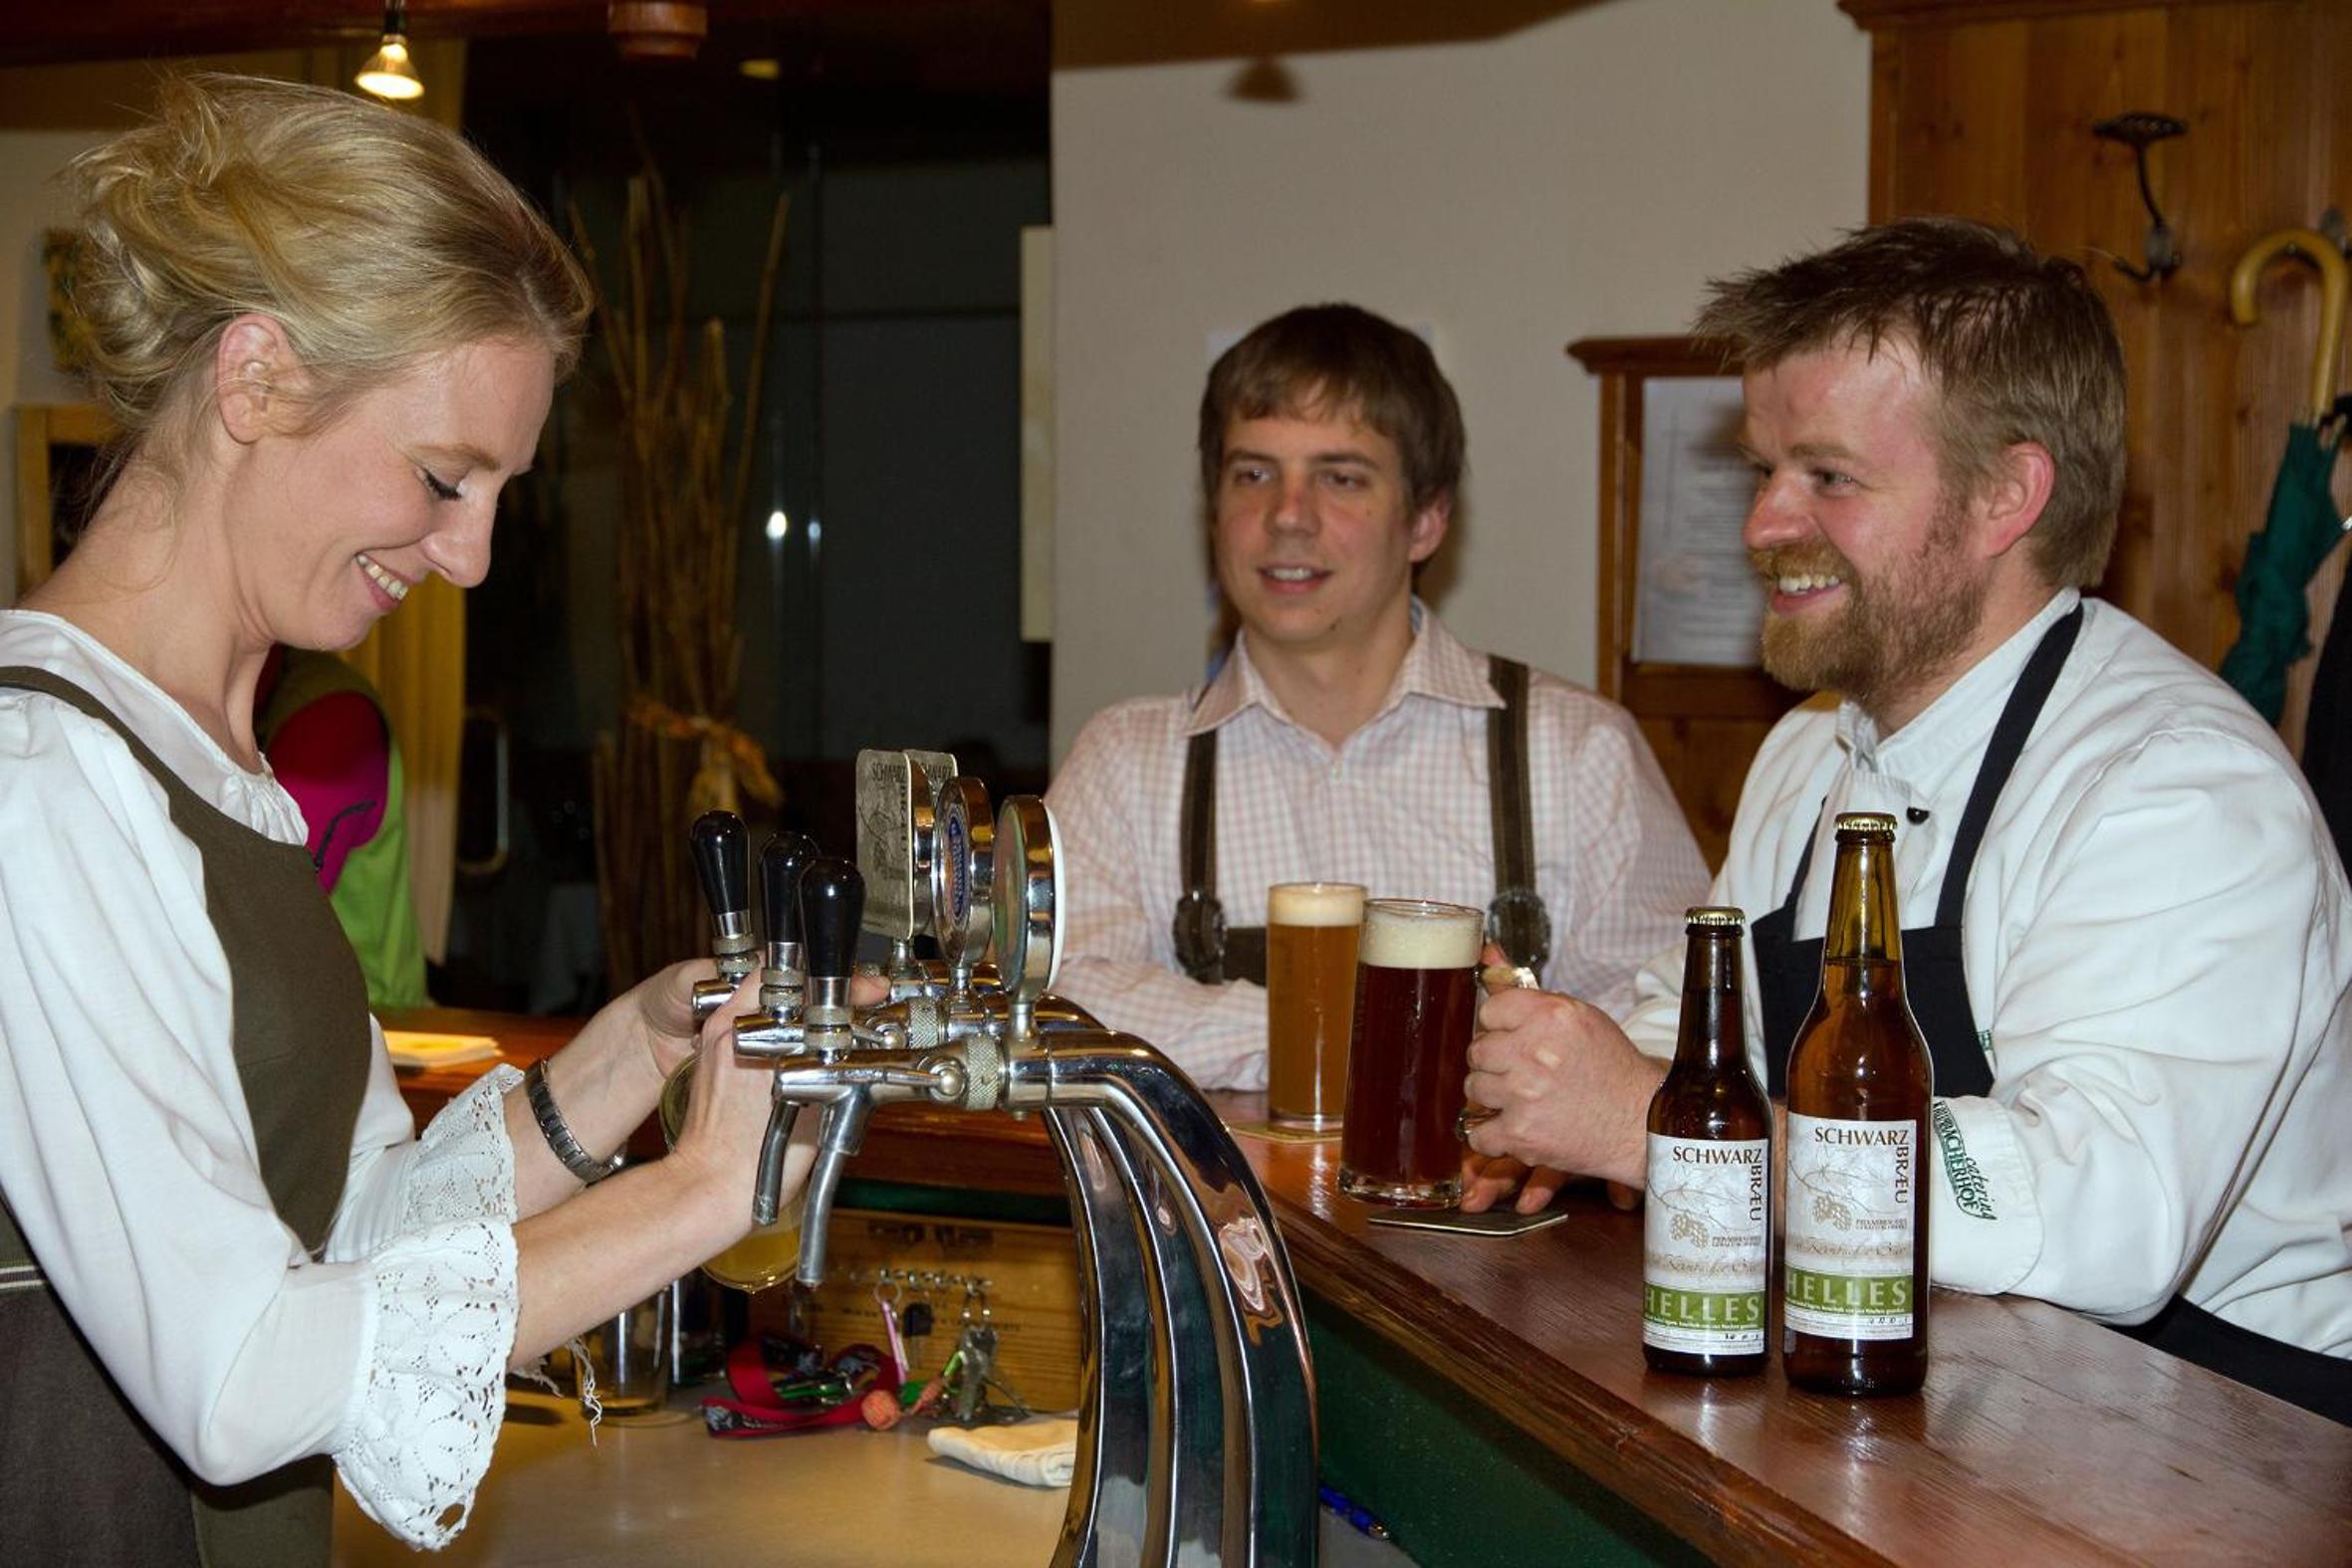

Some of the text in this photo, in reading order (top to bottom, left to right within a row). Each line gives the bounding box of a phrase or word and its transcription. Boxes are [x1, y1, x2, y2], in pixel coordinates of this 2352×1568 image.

[1815, 1126, 1910, 1146] SCHWARZ
[1673, 1146, 1763, 1165] SCHWARZ
[1966, 1157, 1998, 1221] catering
[1644, 1285, 1760, 1322] HELLES
[1785, 1273, 1906, 1306] HELLES
